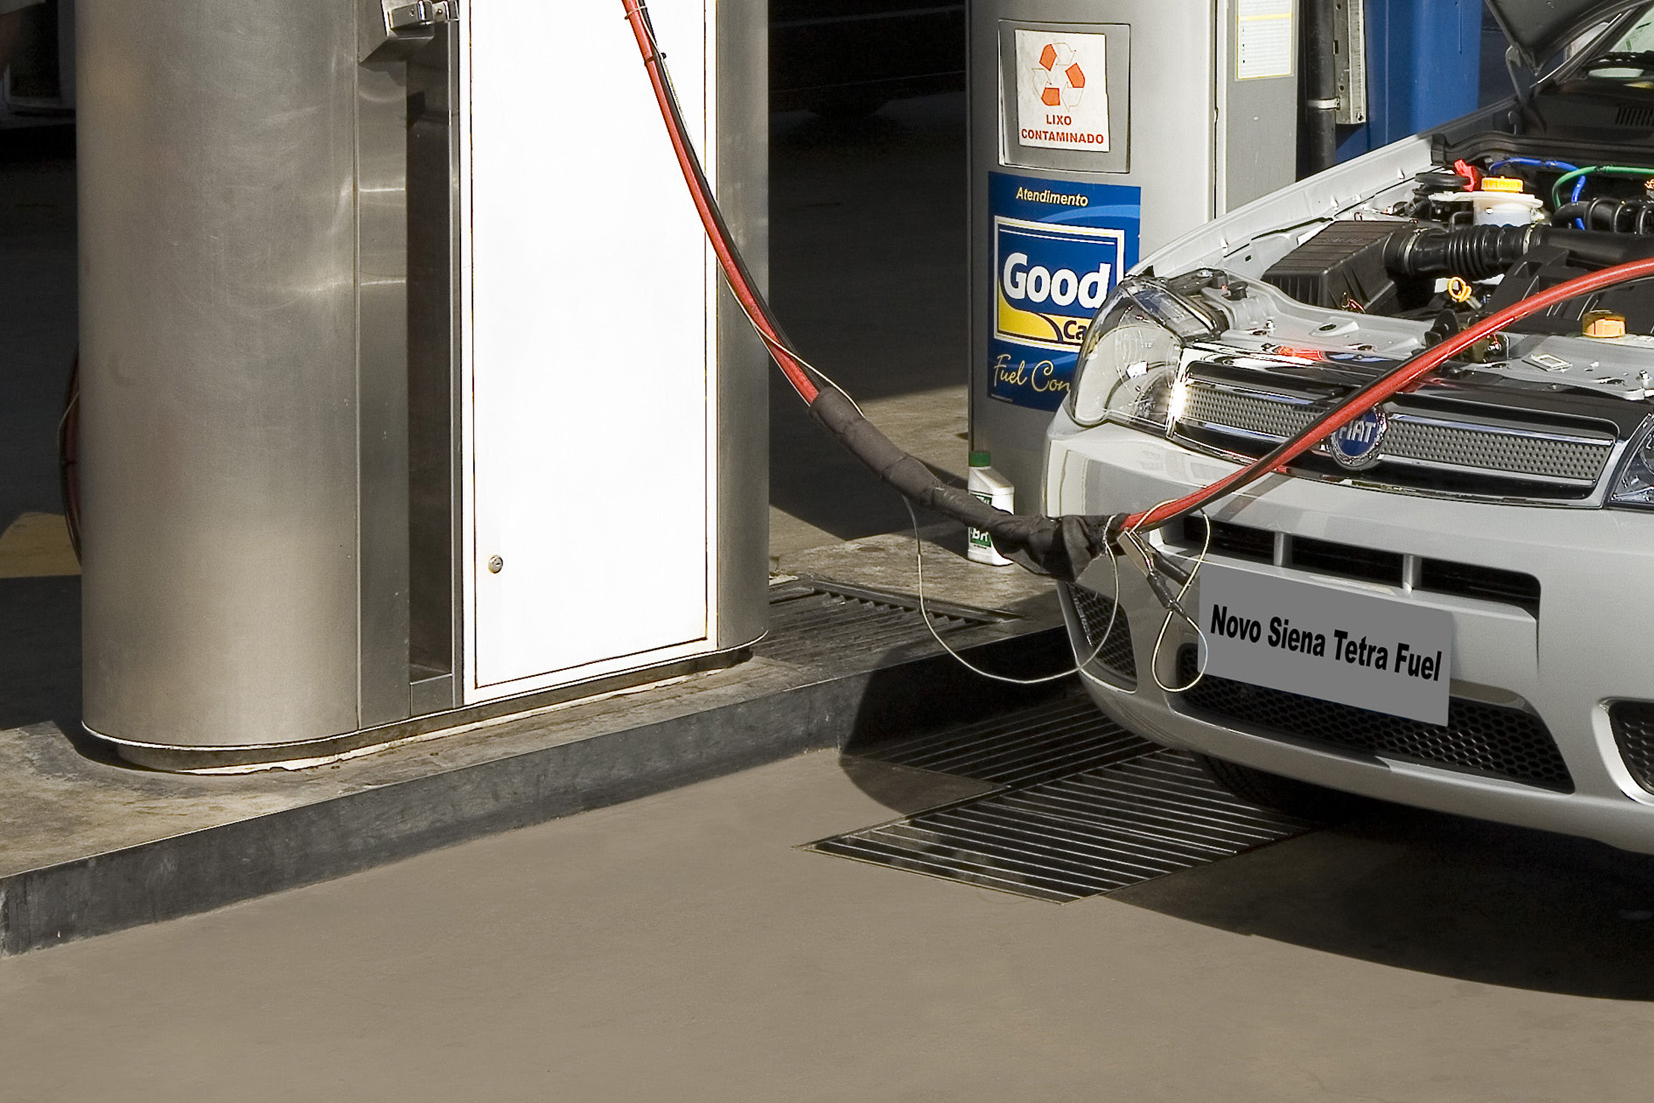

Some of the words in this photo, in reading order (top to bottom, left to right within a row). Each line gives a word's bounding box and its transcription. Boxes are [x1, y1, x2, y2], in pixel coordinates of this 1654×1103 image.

[1046, 114, 1072, 126] LIXO
[1021, 128, 1104, 144] CONTAMINADO
[1016, 186, 1089, 207] Atendimento
[1003, 252, 1112, 309] Good
[993, 353, 1028, 387] Fuel
[1339, 420, 1376, 443] FIAT
[1210, 604, 1262, 643] Novo
[1267, 616, 1325, 657] Siena
[1333, 629, 1388, 671] Tetra
[1394, 642, 1443, 681] Fuel
